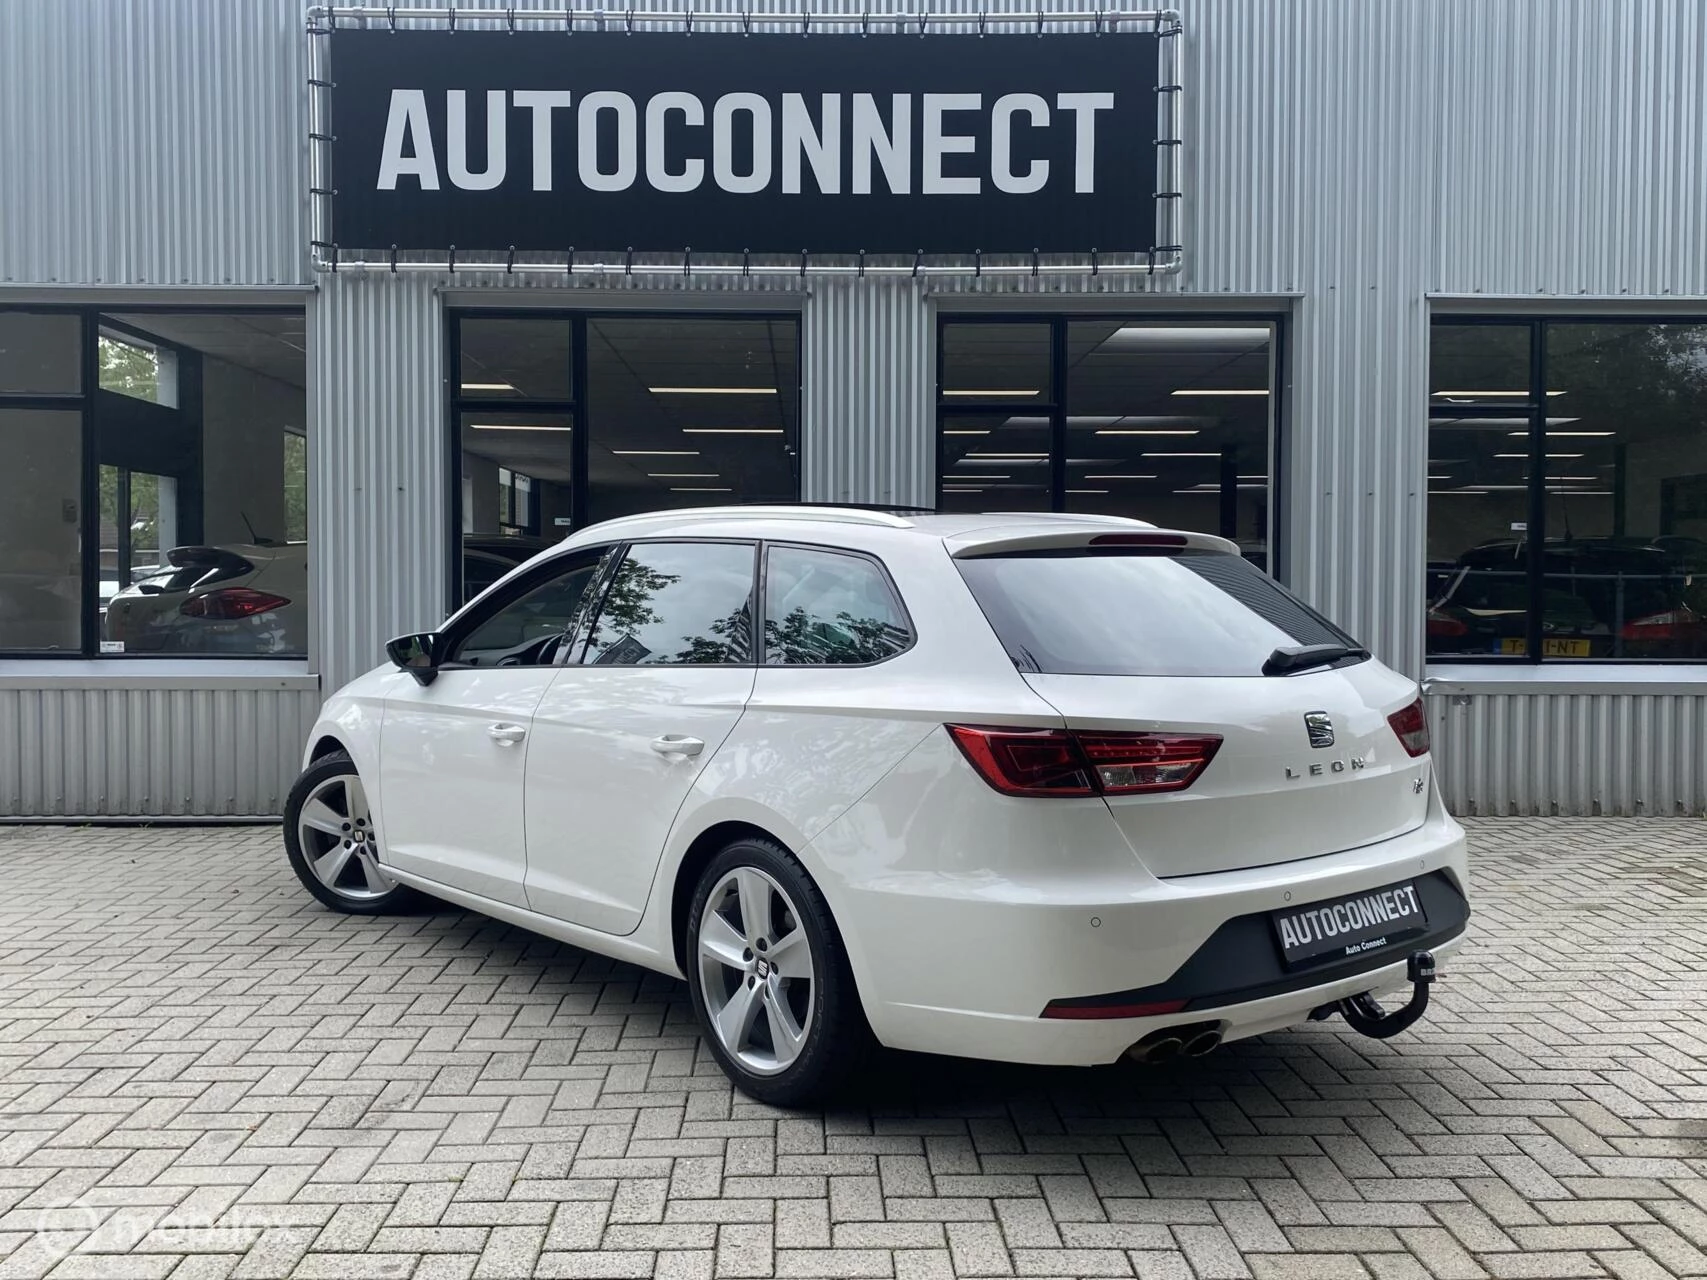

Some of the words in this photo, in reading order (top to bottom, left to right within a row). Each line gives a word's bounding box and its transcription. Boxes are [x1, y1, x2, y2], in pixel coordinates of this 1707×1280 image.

[376, 88, 1116, 196] AUTOCONNECT
[1285, 757, 1364, 780] LEON
[1279, 885, 1419, 949] AUTOCONNECT
[1345, 945, 1361, 955] Auto
[1361, 936, 1387, 951] Connect
